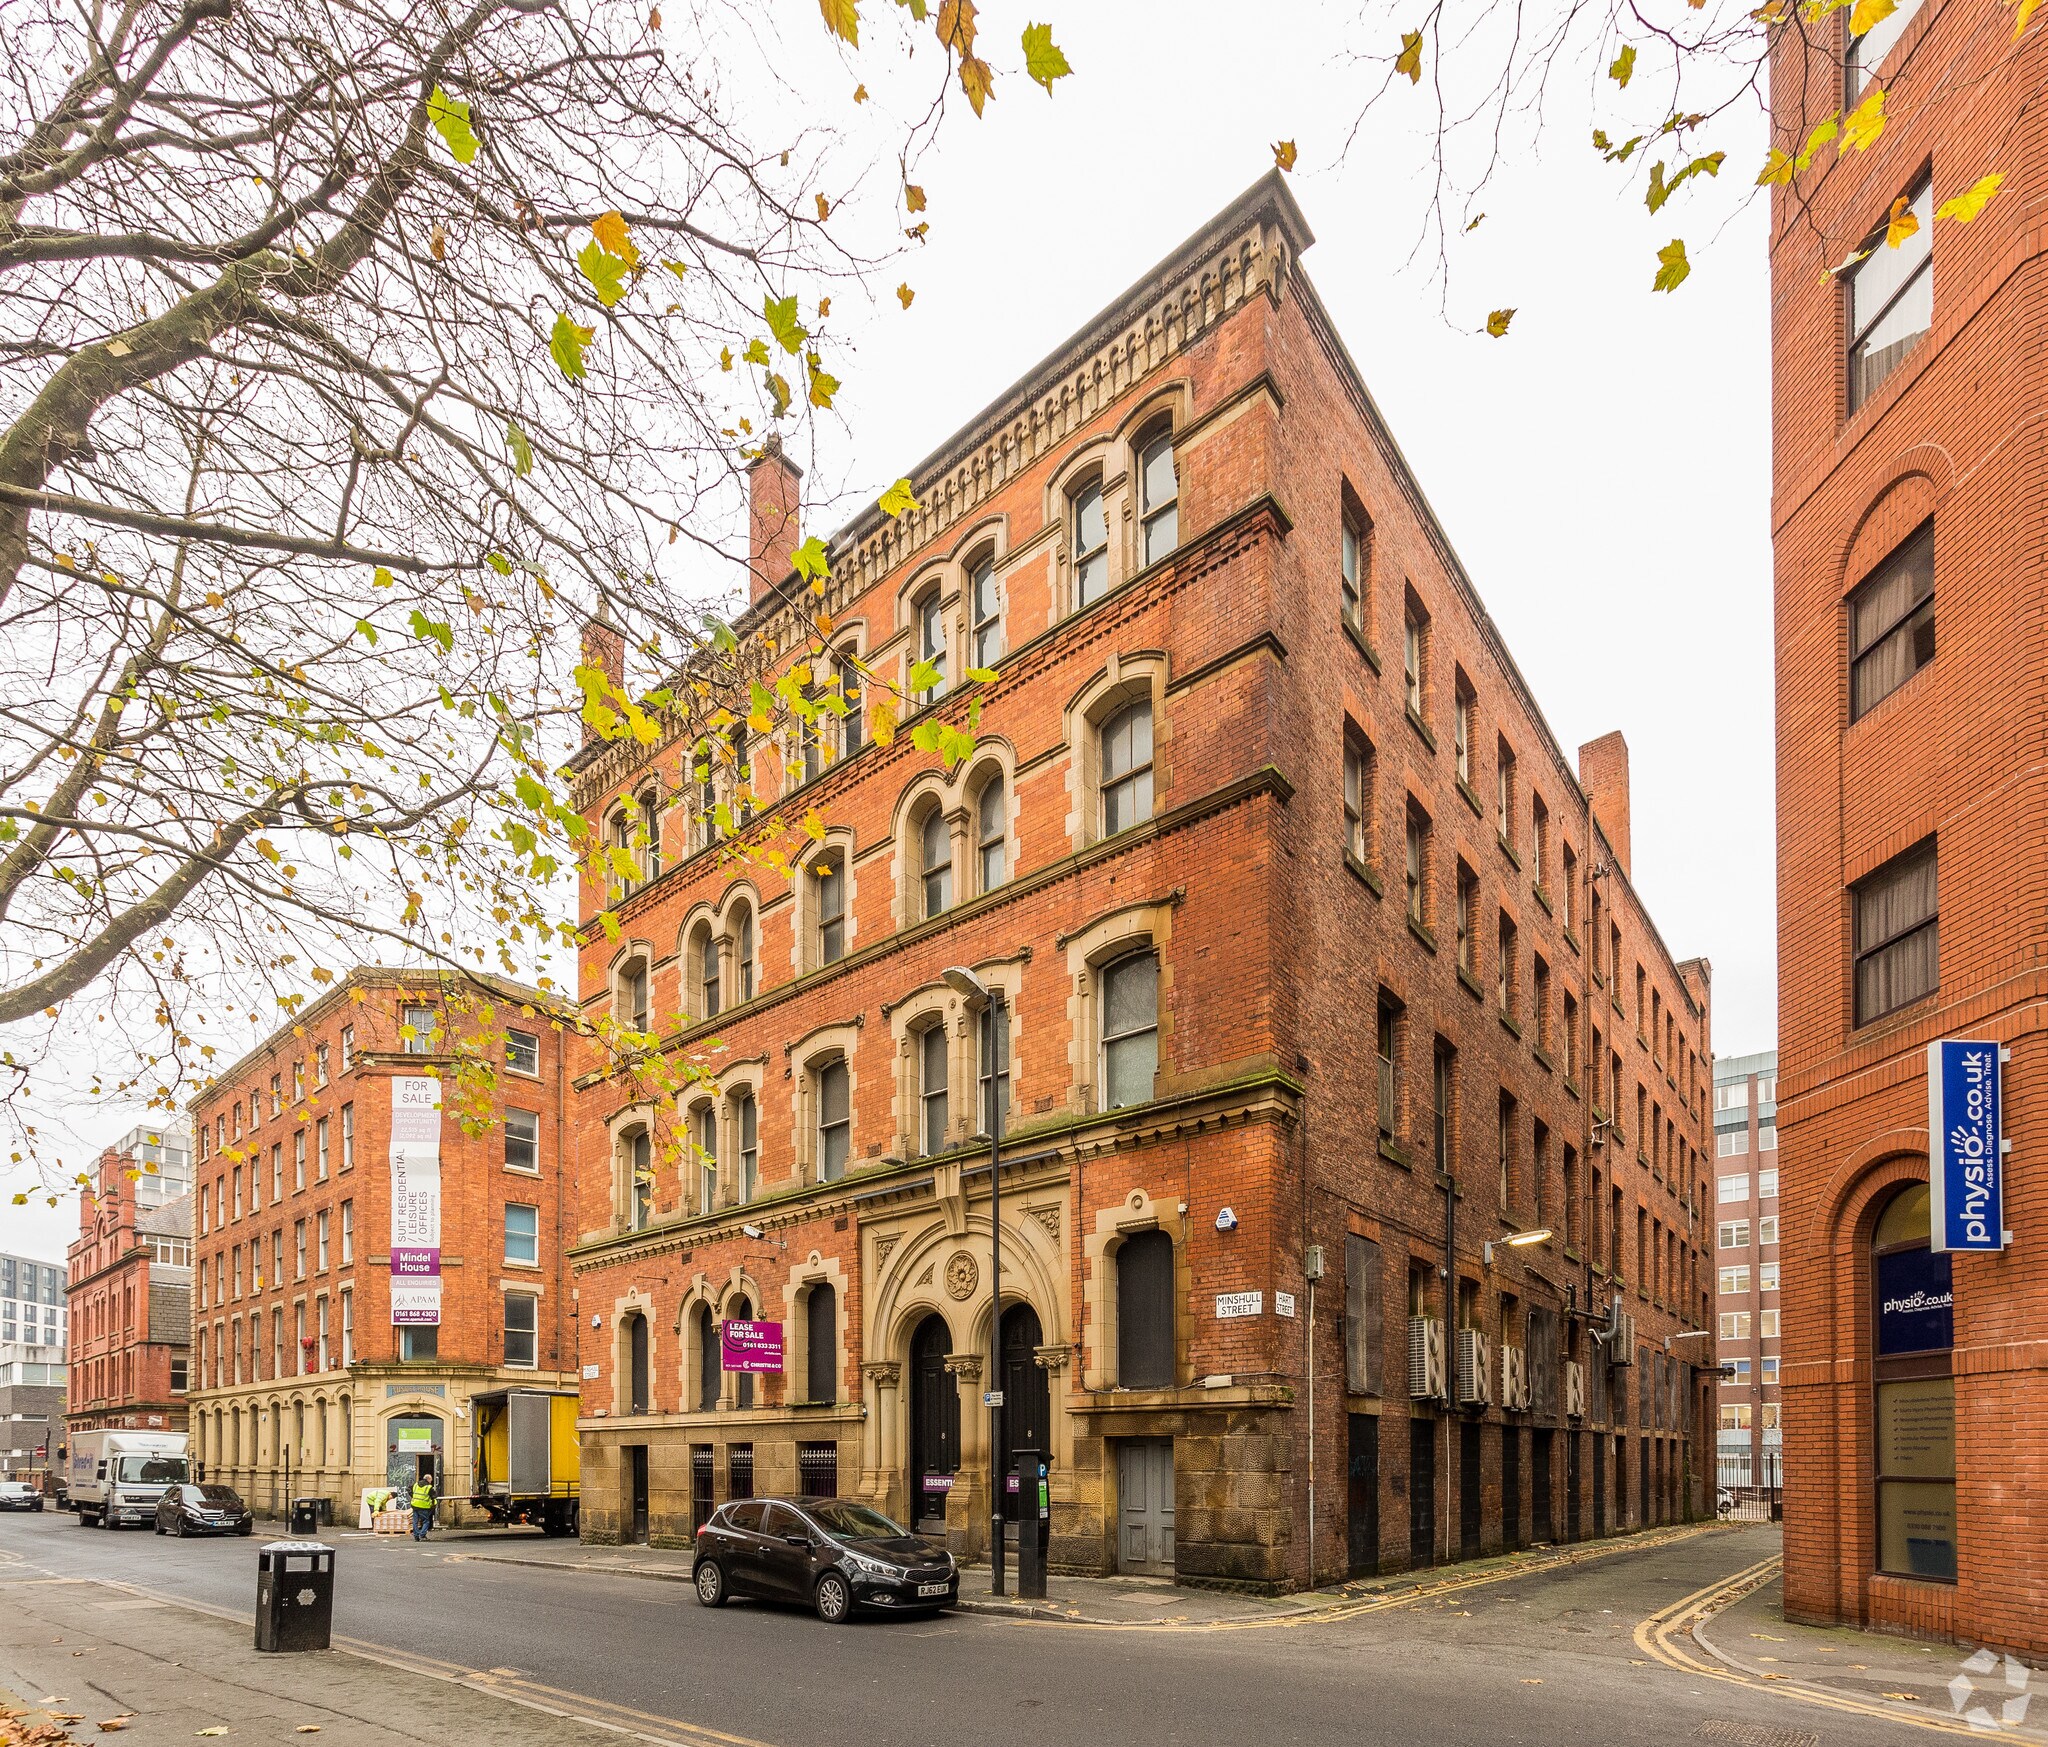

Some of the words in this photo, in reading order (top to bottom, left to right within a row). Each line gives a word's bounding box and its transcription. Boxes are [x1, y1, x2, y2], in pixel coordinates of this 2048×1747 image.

[1983, 1052, 1992, 1076] Treat.
[405, 1081, 428, 1090] FOR
[1984, 1078, 1993, 1110] Advise.
[402, 1094, 432, 1103] SALE
[1985, 1112, 1994, 1154] Diagnose.
[1958, 1052, 1991, 1242] physio.co.uk
[396, 1148, 406, 1215] RESIDENTIAL
[1986, 1157, 1994, 1188] Assess.
[408, 1192, 417, 1234] LEISURE
[419, 1192, 428, 1234] OFFICES
[398, 1220, 406, 1242] SUIT
[400, 1253, 431, 1262] Mindel
[400, 1262, 430, 1271] House
[1217, 1293, 1260, 1305] MINSHULL
[1221, 1304, 1253, 1315] STREET
[1277, 1303, 1292, 1314] STREET
[1278, 1294, 1292, 1303] HART
[1884, 1292, 1953, 1314] physio.co.uk
[921, 1586, 936, 1594] RJ62
